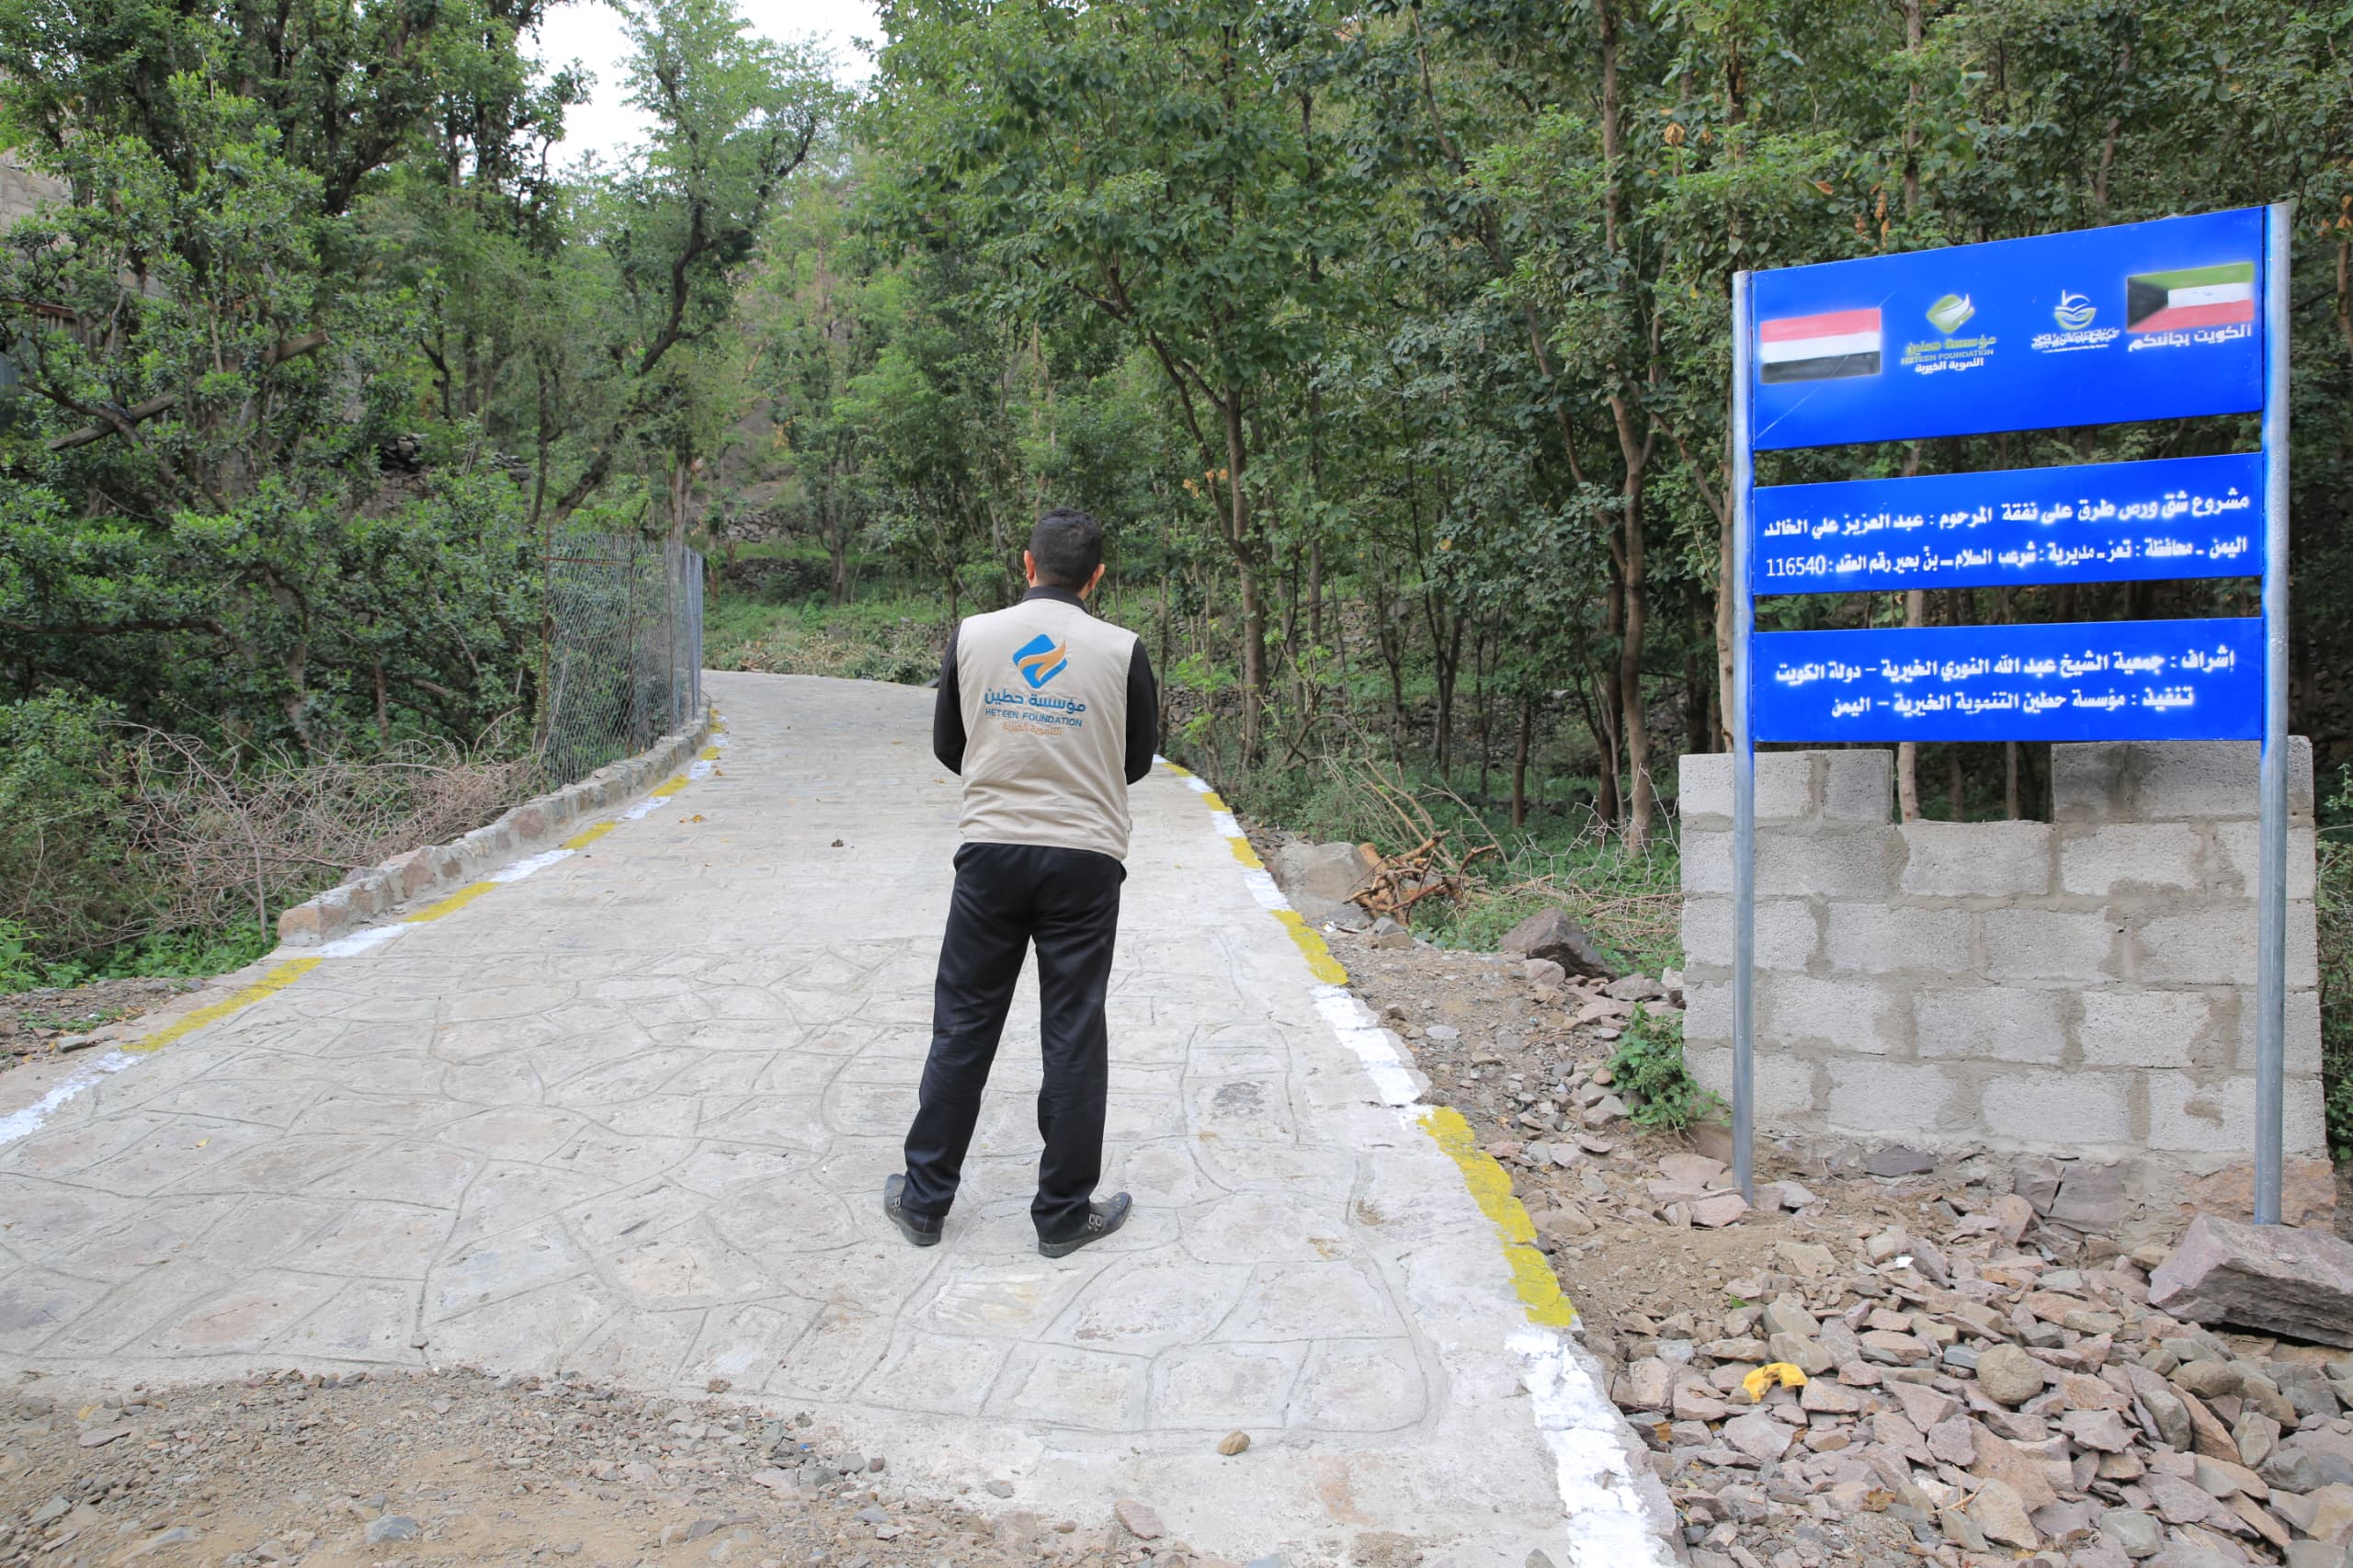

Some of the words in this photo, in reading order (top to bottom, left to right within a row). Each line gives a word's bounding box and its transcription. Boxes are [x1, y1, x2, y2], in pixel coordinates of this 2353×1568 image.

[2194, 324, 2251, 344] الكويت
[2002, 502, 2039, 522] نفقة
[2077, 499, 2115, 522] طرق
[2161, 490, 2188, 519] شق
[2191, 487, 2250, 517] مشروع
[1841, 513, 1891, 536] العزيز
[1893, 513, 1924, 532] عبد
[1939, 506, 1993, 529] المرحوم
[2040, 503, 2073, 525] على
[1764, 517, 1808, 537] الخالد
[1811, 517, 1839, 540] علي
[2047, 541, 2095, 567] مديرية
[2106, 539, 2132, 563] تعز
[2144, 537, 2193, 557] محافظة
[2210, 536, 2247, 559] اليمن
[1766, 554, 1826, 577] 116540
[1836, 553, 1867, 573] العقد
[1869, 551, 1892, 574] رقم
[1955, 548, 1993, 571] السلام
[1940, 656, 1990, 682] النوري
[1994, 654, 2020, 675] الله
[2023, 657, 2057, 679] عبد
[2059, 649, 2109, 678] الشيخ
[2113, 651, 2165, 676] جمعية
[2181, 644, 2235, 673] إشراف
[1775, 662, 1825, 687] الكويت
[1828, 661, 1861, 683] دولة
[1881, 658, 1938, 683] الخيرية
[984, 687, 1024, 706] حطين
[1029, 693, 1086, 715] مؤسسة
[1831, 696, 1871, 718] اليمن
[1893, 691, 1951, 717] الخيرية
[1955, 690, 2019, 715] التنموية
[2022, 691, 2067, 714] حطين
[2072, 687, 2126, 712] مؤسسة
[2142, 686, 2194, 711] تنفيذ
[984, 708, 1019, 720] HETEEN
[1022, 711, 1083, 727] FOUNDATION
